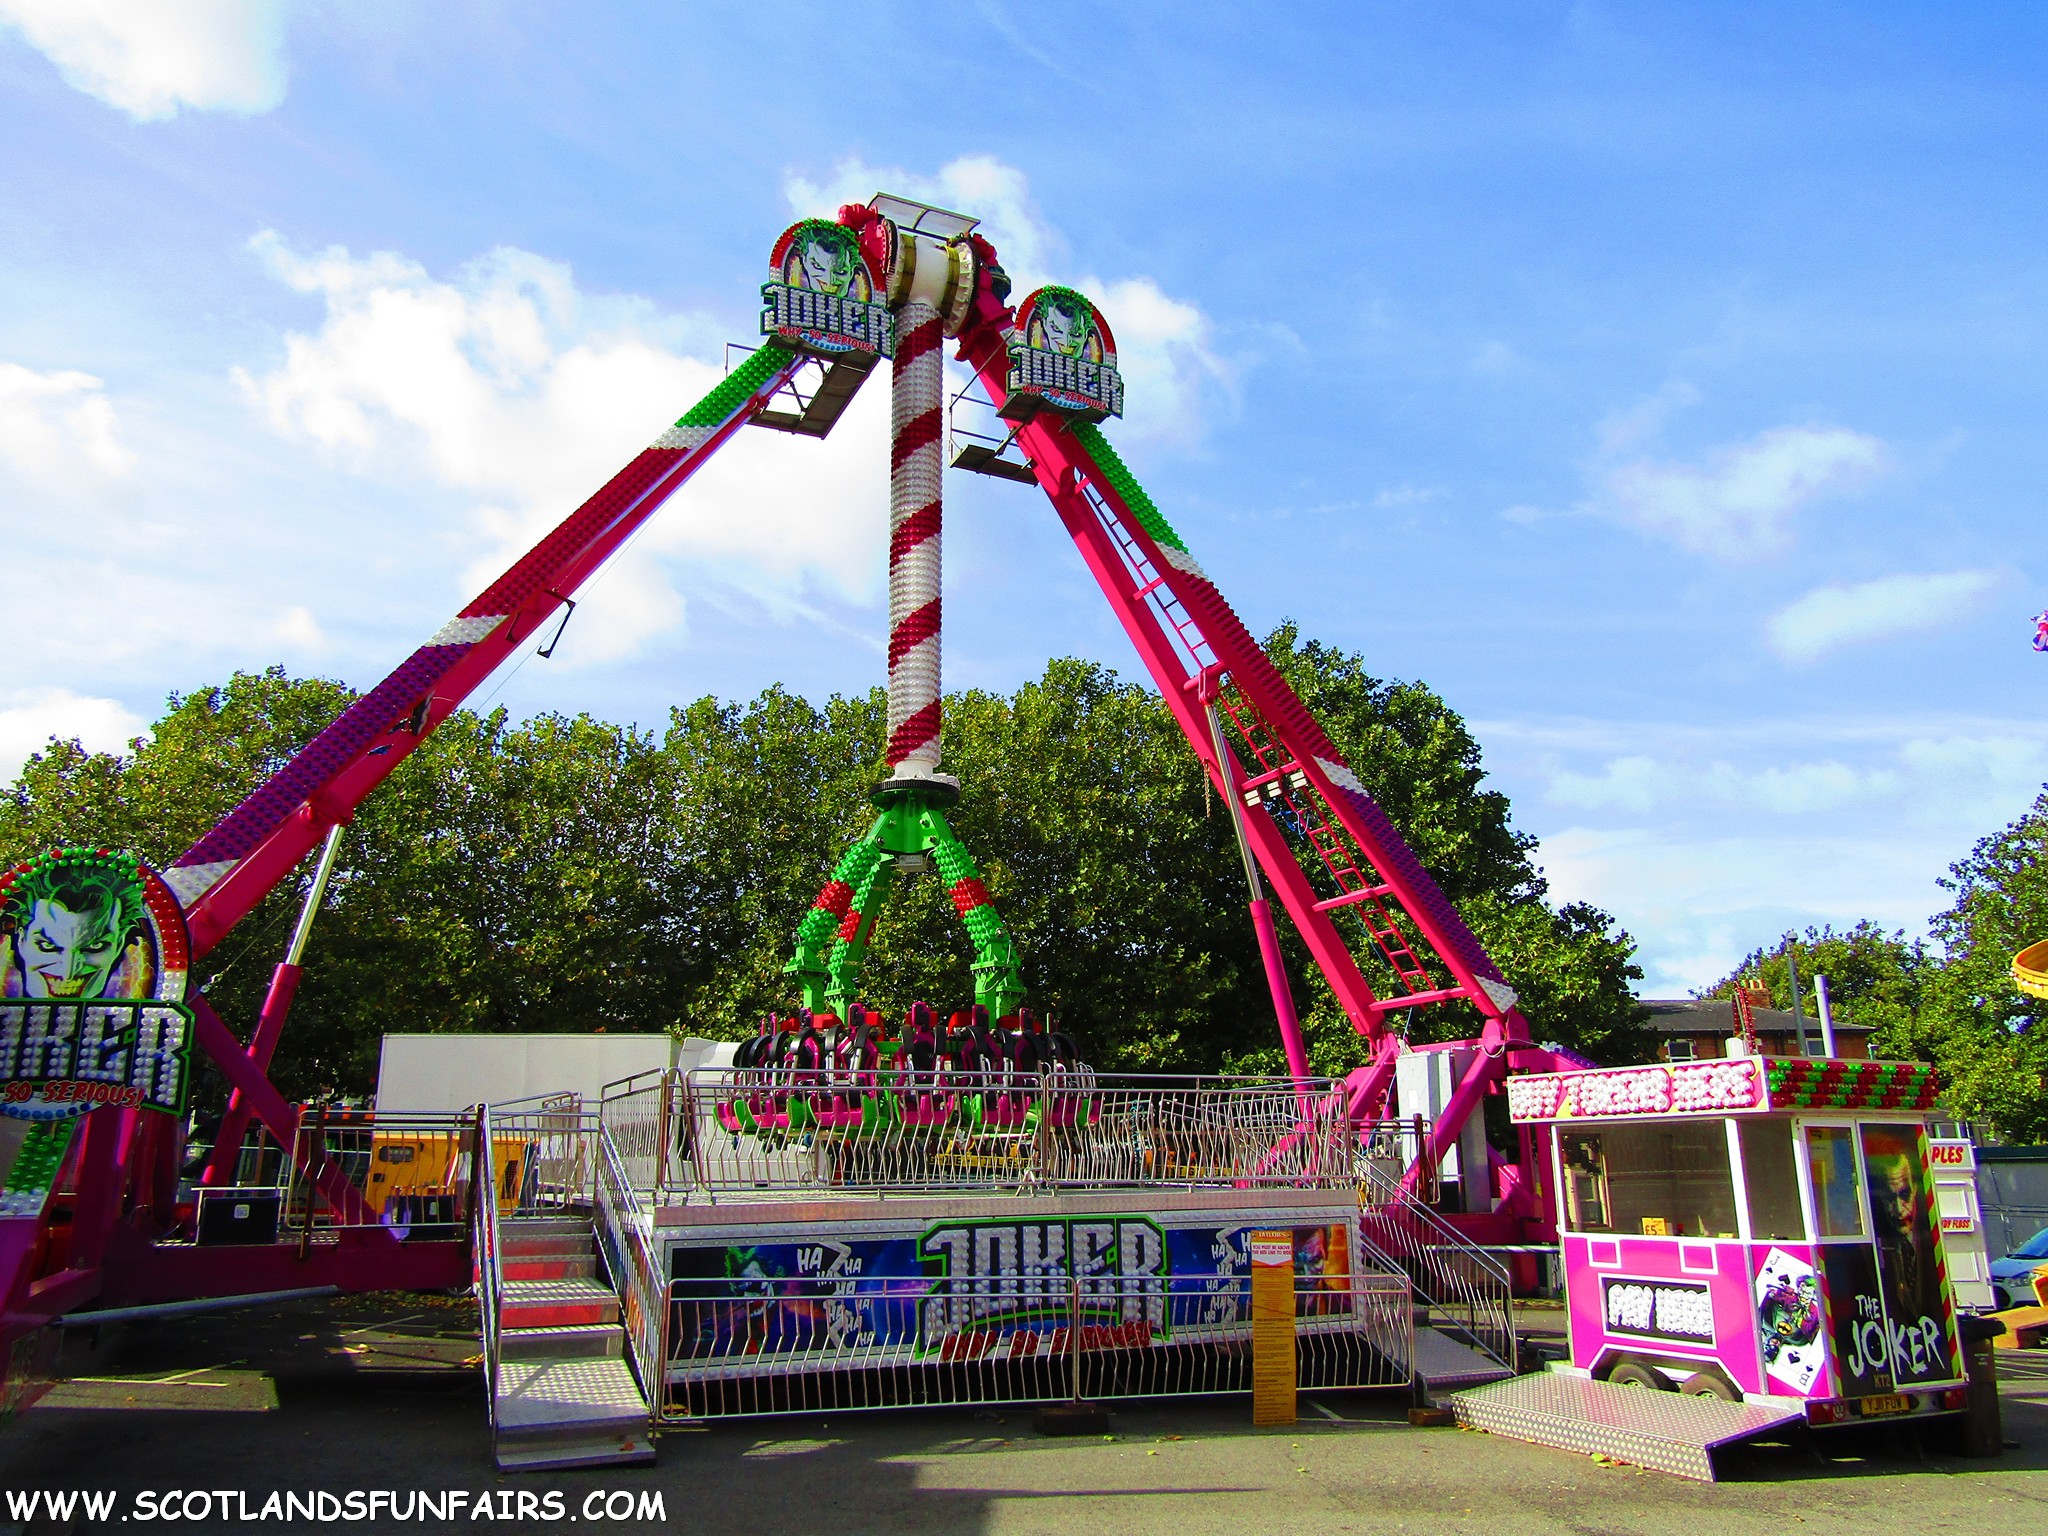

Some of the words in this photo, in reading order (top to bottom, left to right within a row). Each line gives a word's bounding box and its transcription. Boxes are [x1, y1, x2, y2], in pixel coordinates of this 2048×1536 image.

[764, 285, 892, 356] JOKER
[778, 326, 802, 339] WHY
[808, 329, 823, 340] SO
[826, 333, 876, 355] SERIOUS!
[1010, 346, 1121, 414] JOKER
[1022, 384, 1043, 396] WHY
[1048, 388, 1060, 398] SO
[4, 1081, 32, 1103] SO
[43, 1080, 146, 1111] SERIOUS!
[797, 1247, 823, 1273] HA
[1211, 1244, 1225, 1259] HA
[1234, 1253, 1248, 1267] HA
[844, 1258, 862, 1275] HA
[925, 1223, 1164, 1344] JOKER
[1206, 1279, 1219, 1292] HA
[1608, 1284, 1653, 1329] PAY
[1655, 1287, 1712, 1336] HERE
[1855, 1294, 1881, 1320] THE
[1848, 1315, 1945, 1378] JOKER
